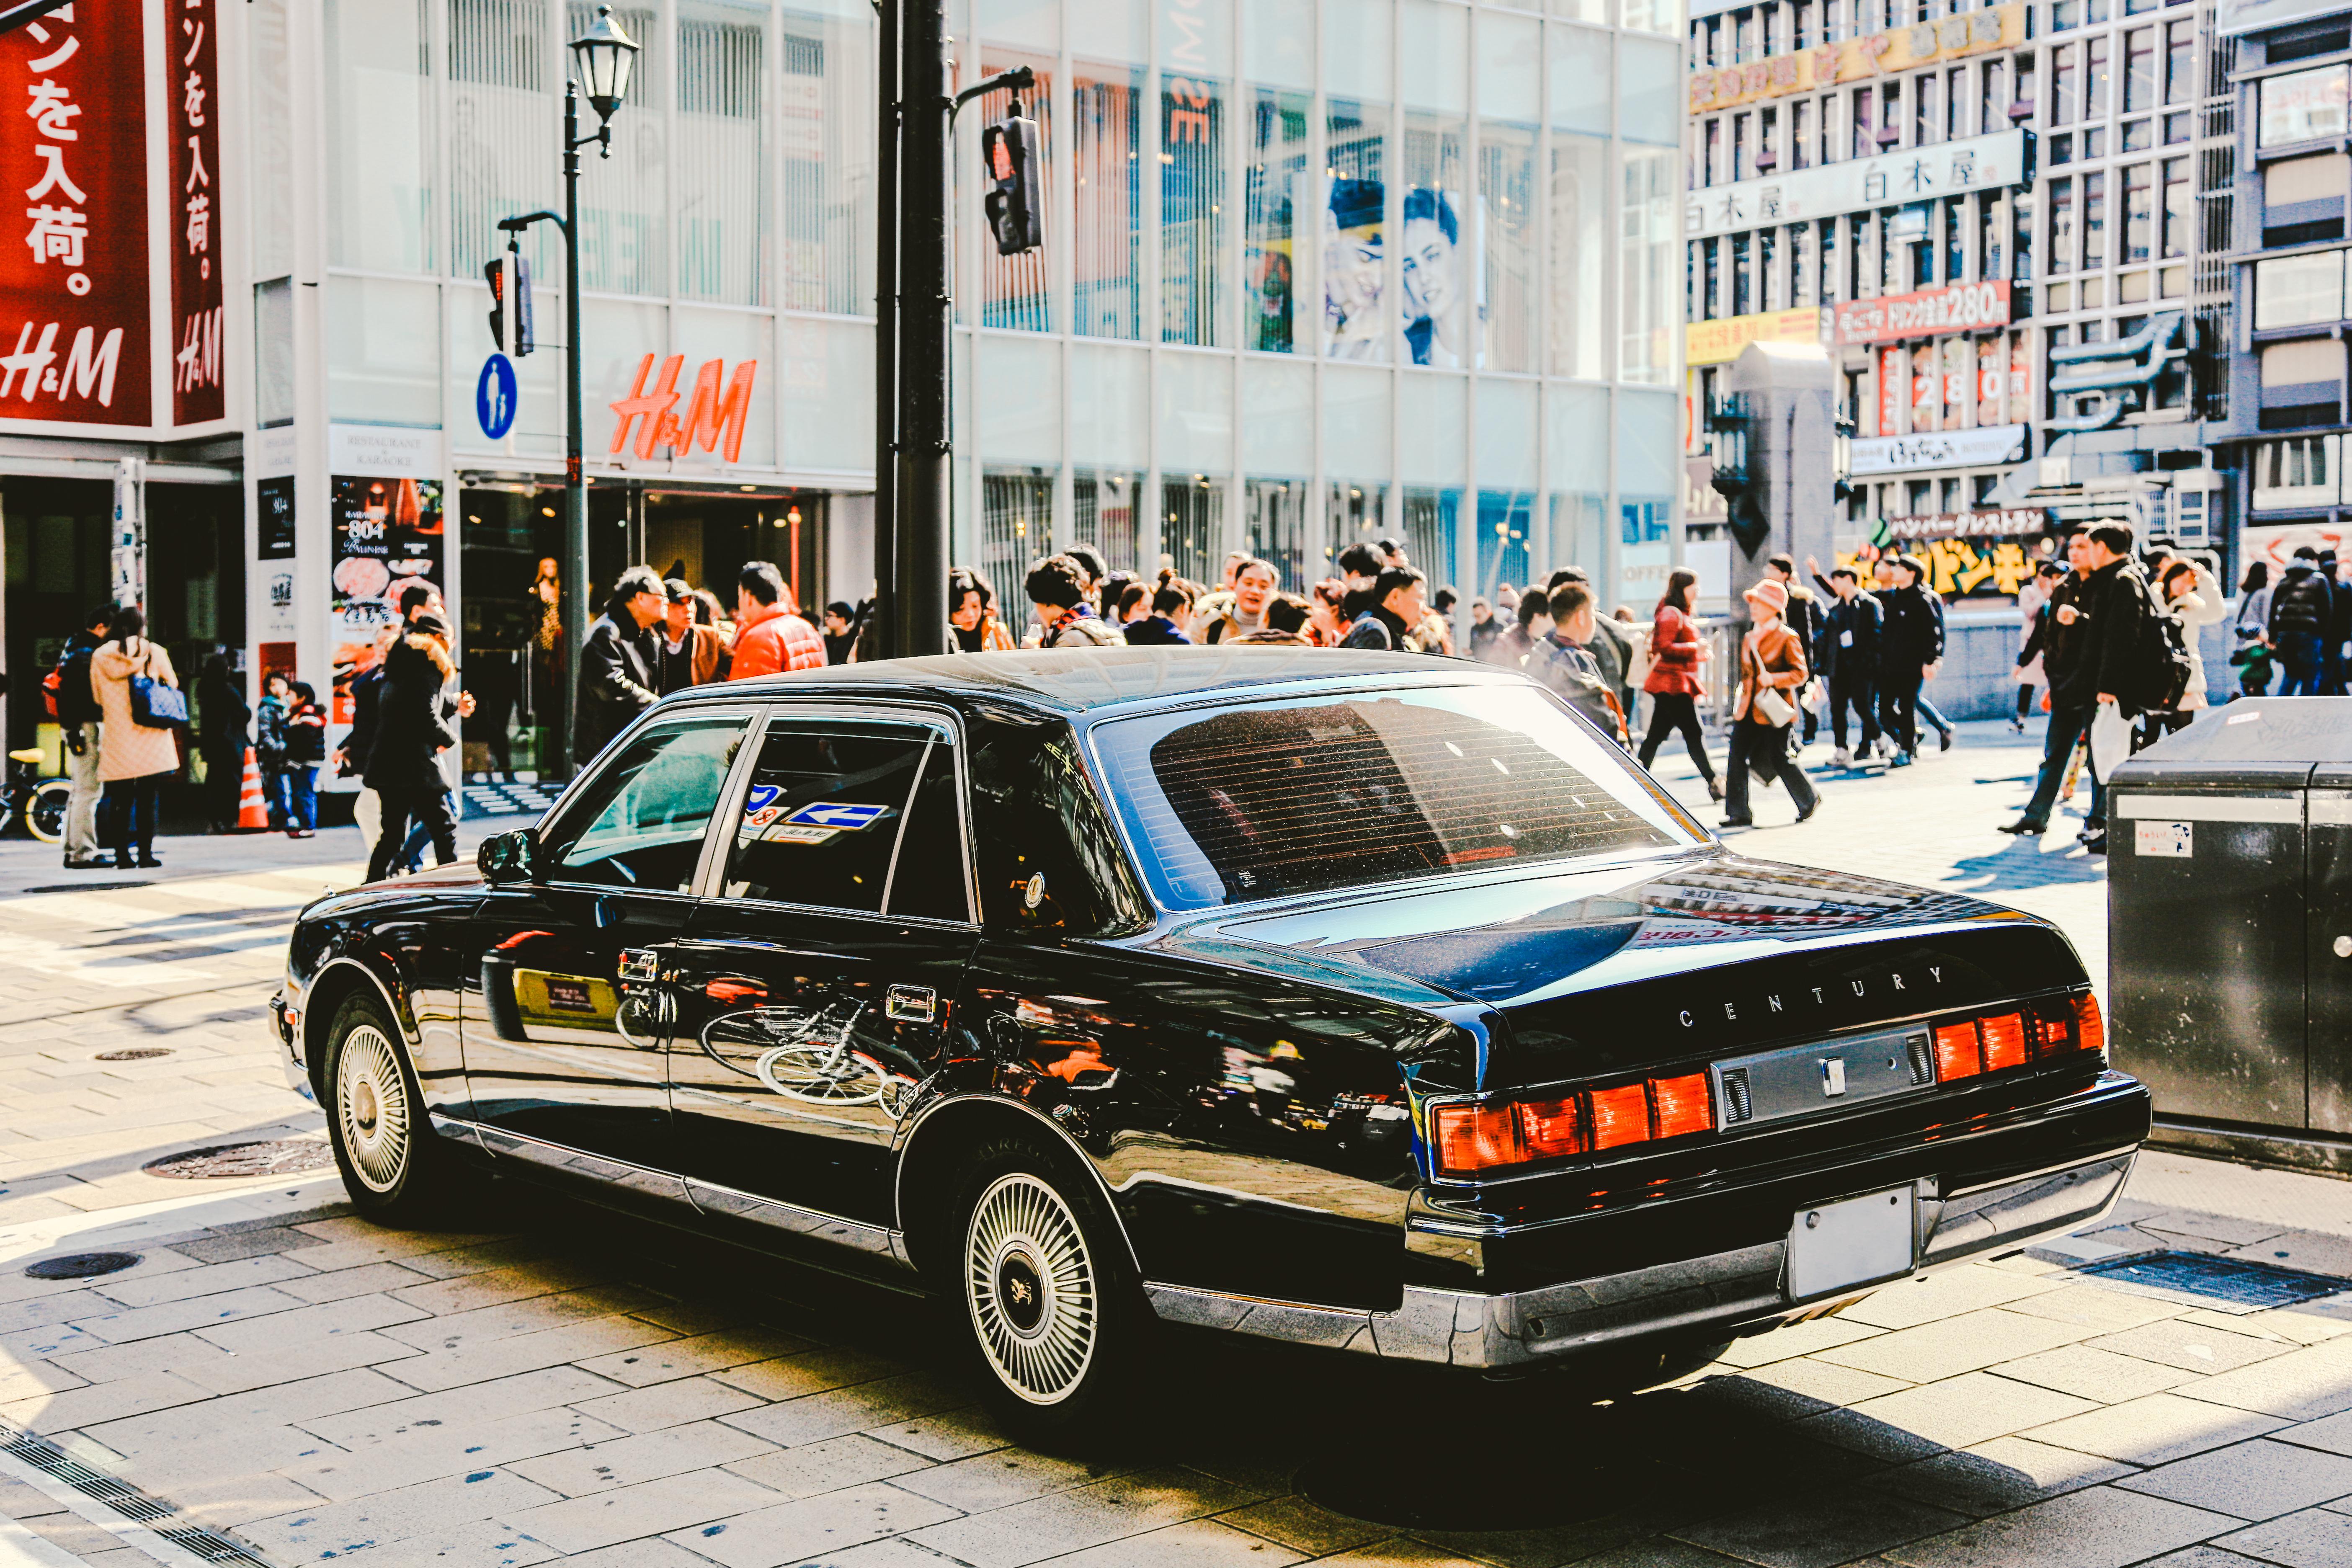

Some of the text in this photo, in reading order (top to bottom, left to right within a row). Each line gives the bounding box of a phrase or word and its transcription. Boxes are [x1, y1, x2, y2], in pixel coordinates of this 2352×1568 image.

[1864, 150, 1978, 202] 白木屋
[0, 322, 123, 407] H&M
[176, 306, 222, 393] H&M
[610, 353, 757, 463] H&M
[347, 435, 421, 449] RESTAURANT
[356, 454, 412, 466] KARAOKE
[348, 520, 384, 540] 804
[1890, 510, 2044, 538] ハンバーグレストラン
[1679, 966, 1941, 1027] CENTURY
